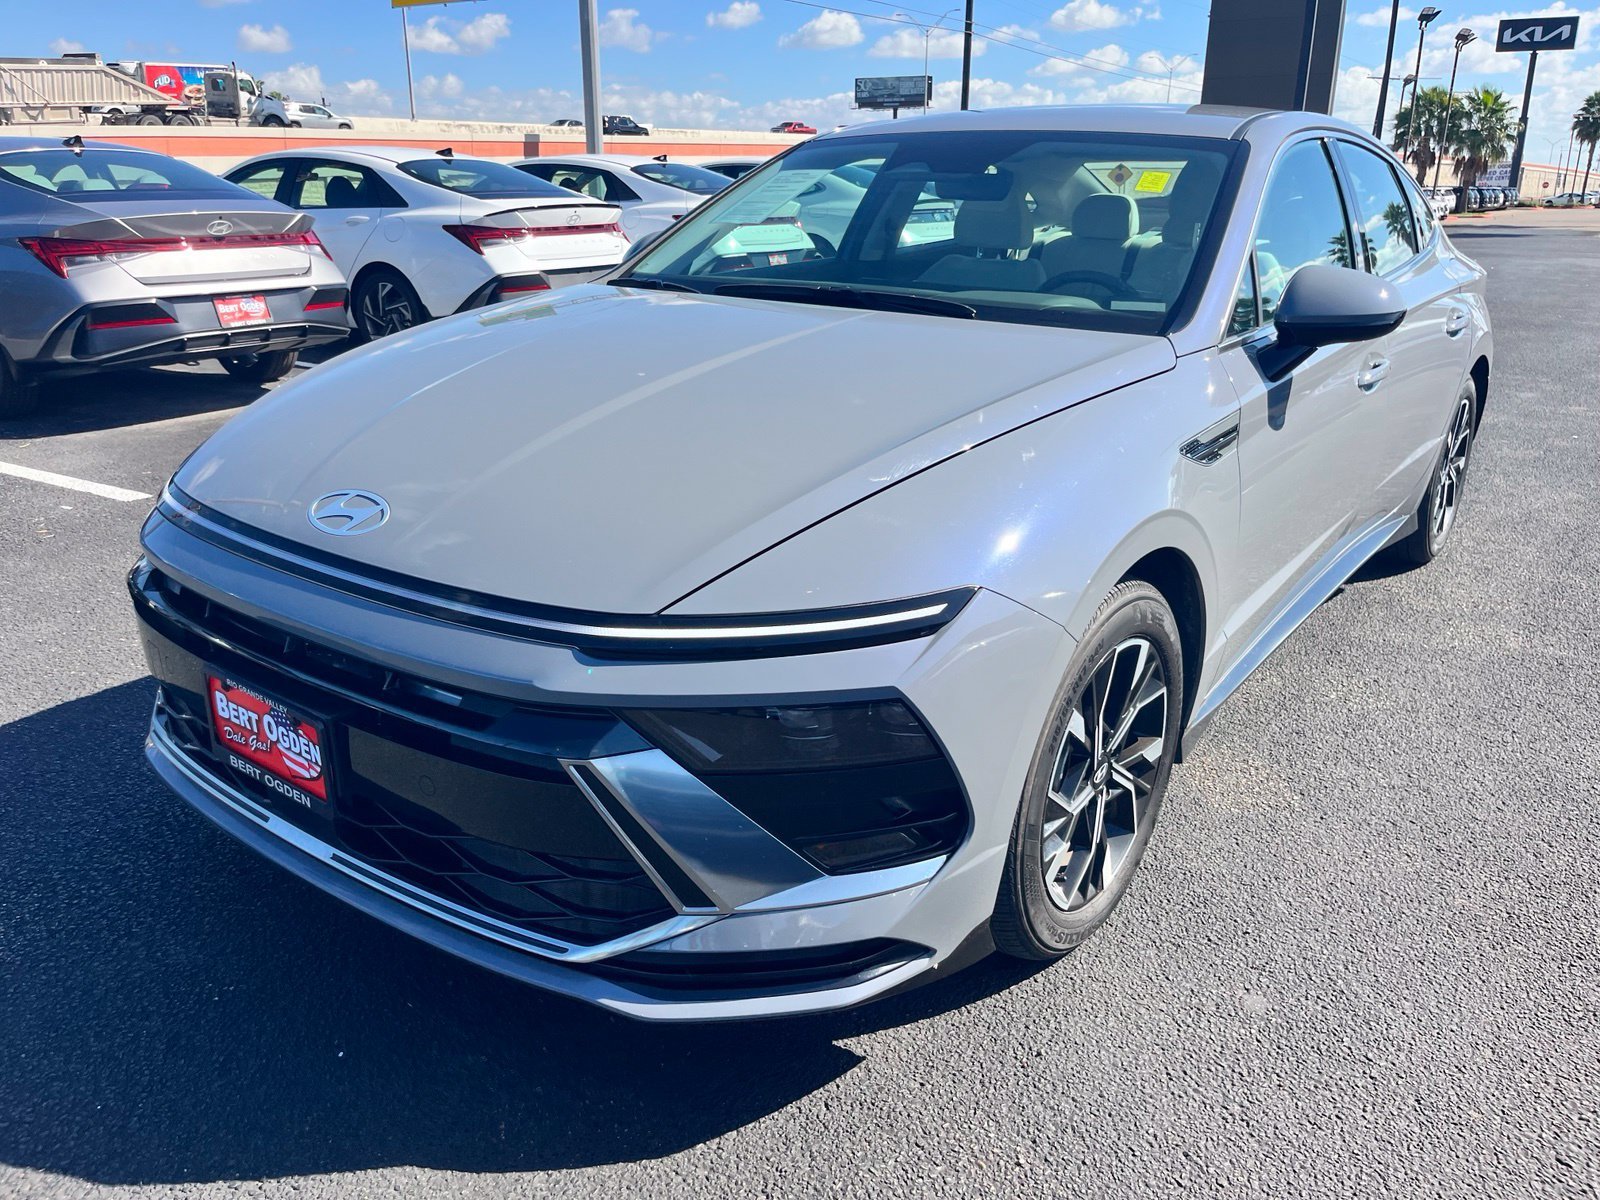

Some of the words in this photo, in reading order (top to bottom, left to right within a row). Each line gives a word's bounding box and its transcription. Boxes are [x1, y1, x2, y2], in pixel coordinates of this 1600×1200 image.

[1502, 24, 1571, 43] KIA
[154, 74, 170, 88] FUD
[218, 303, 239, 313] BERT
[226, 678, 238, 688] RIO
[238, 684, 264, 703] GRANDE
[264, 697, 288, 714] VALLEY
[215, 690, 259, 733] BERT
[262, 713, 322, 766] OGDEN
[223, 726, 246, 745] Dale
[248, 735, 271, 752] Gas!
[229, 754, 261, 780] BERT
[264, 774, 311, 808] OGDEN
